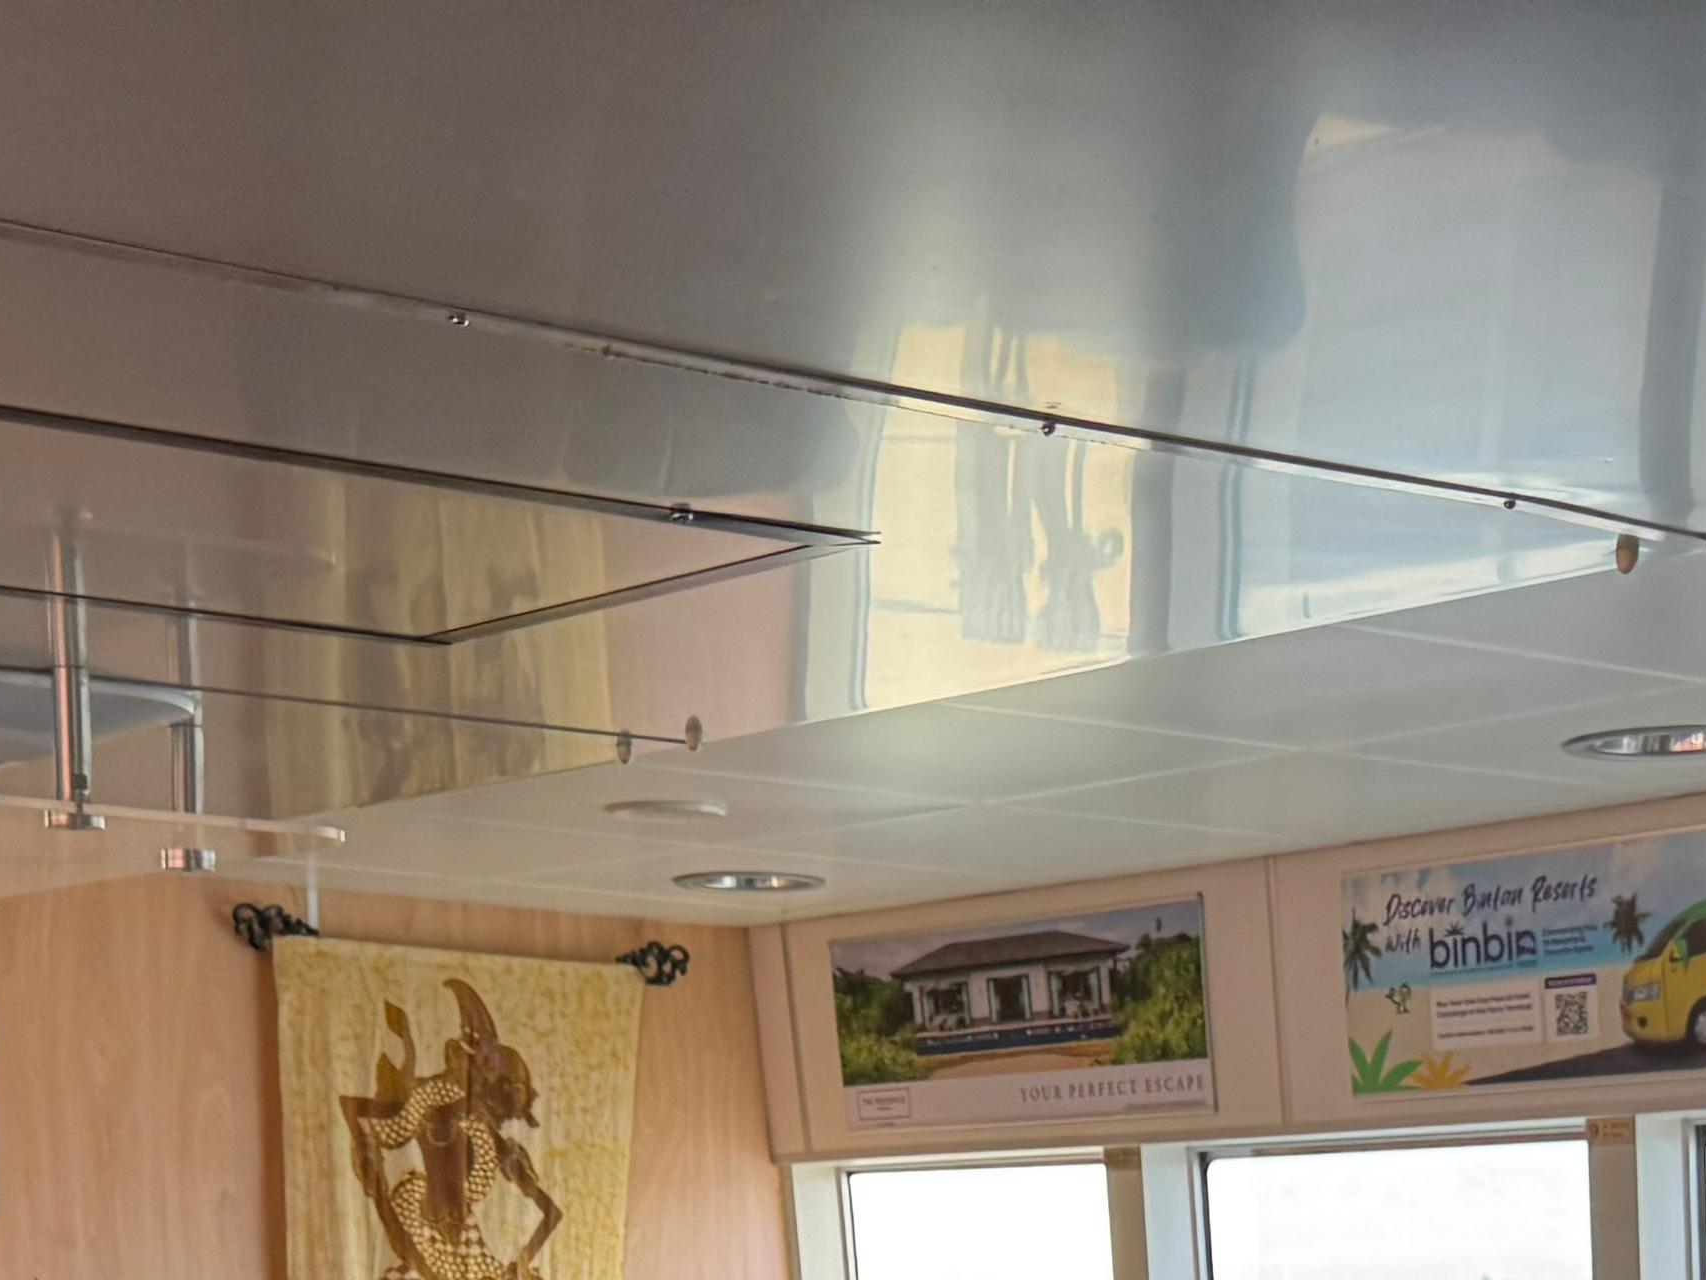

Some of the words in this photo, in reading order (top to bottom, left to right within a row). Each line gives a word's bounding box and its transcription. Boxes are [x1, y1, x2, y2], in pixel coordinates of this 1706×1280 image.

[1383, 893, 1455, 926] Discover
[1531, 874, 1598, 912] Resorts
[1429, 917, 1537, 969] binbin
[1020, 1085, 1062, 1103] YOUR
[1068, 1079, 1138, 1099] PERFECT
[1145, 1074, 1205, 1094] ESCAPE
